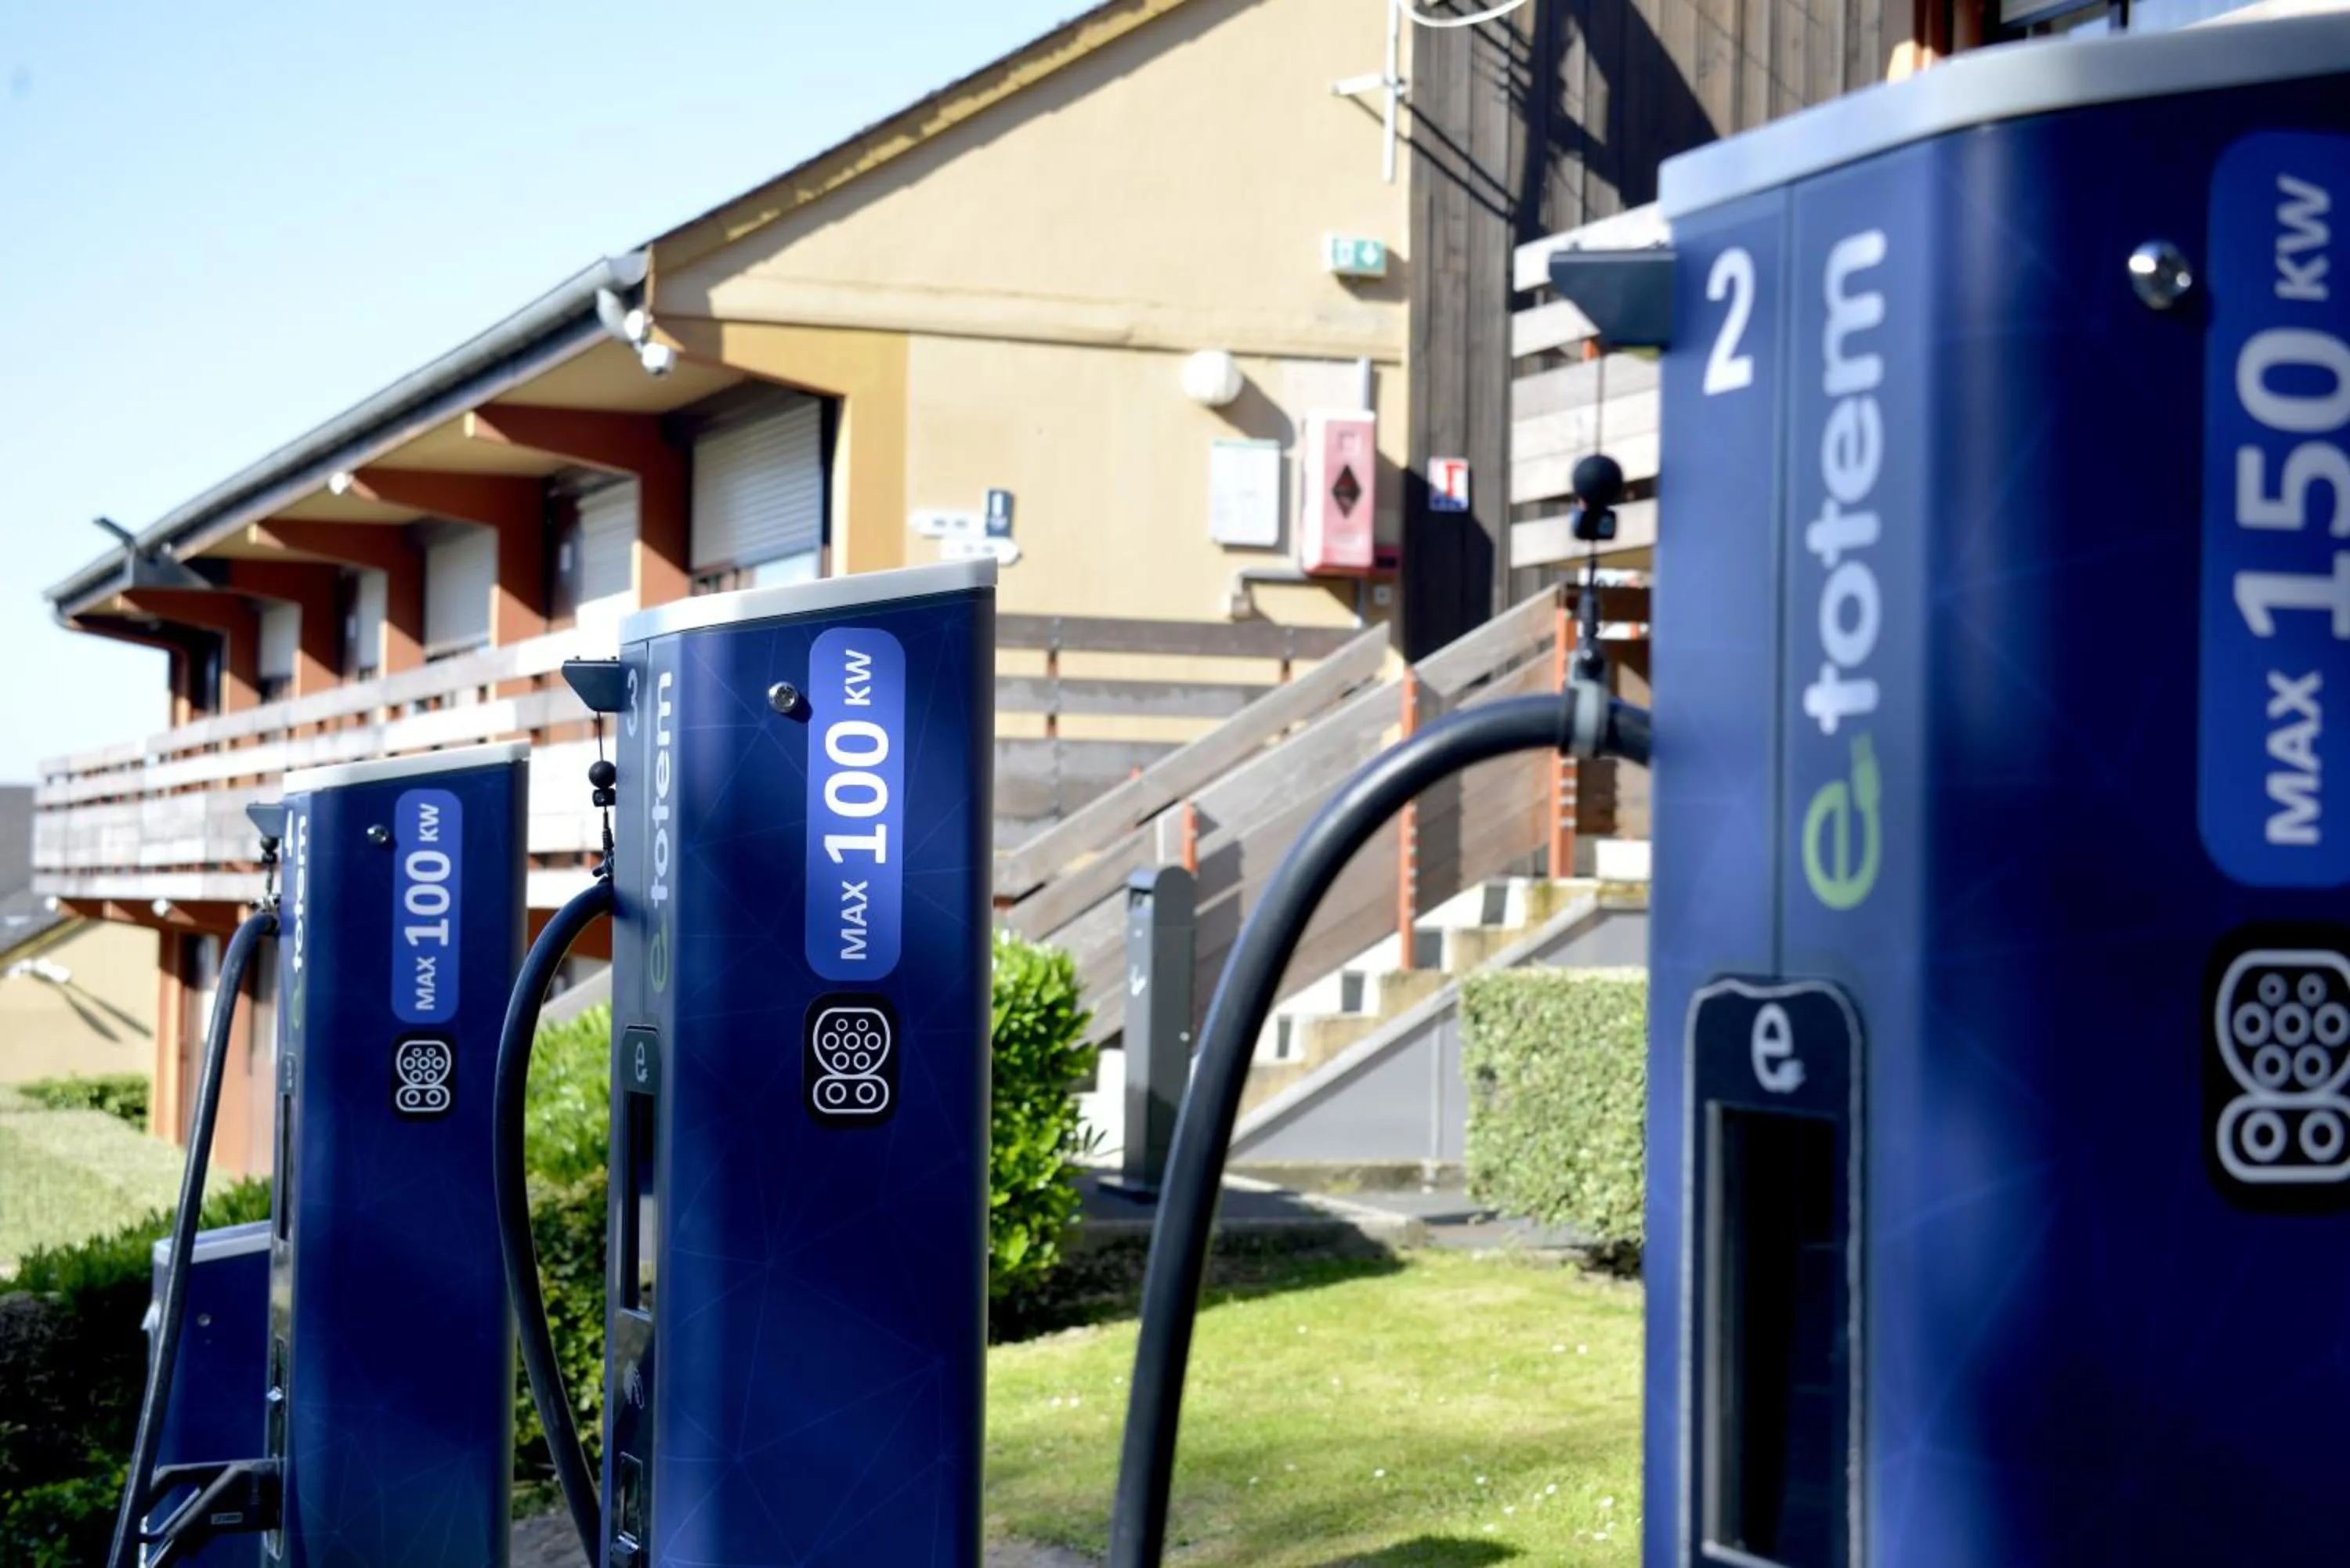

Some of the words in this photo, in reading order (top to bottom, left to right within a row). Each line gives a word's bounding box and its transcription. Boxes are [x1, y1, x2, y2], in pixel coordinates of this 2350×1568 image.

[2275, 175, 2332, 301] KW
[1704, 247, 1755, 395] 2
[2232, 327, 2350, 640] 150
[627, 668, 638, 737] 3
[843, 649, 872, 706] KW
[824, 721, 888, 864] 100
[2265, 670, 2322, 847] MAX
[419, 804, 439, 842] KW
[404, 850, 451, 946] 100
[841, 881, 866, 959] MAX
[415, 956, 436, 1010] MAX
